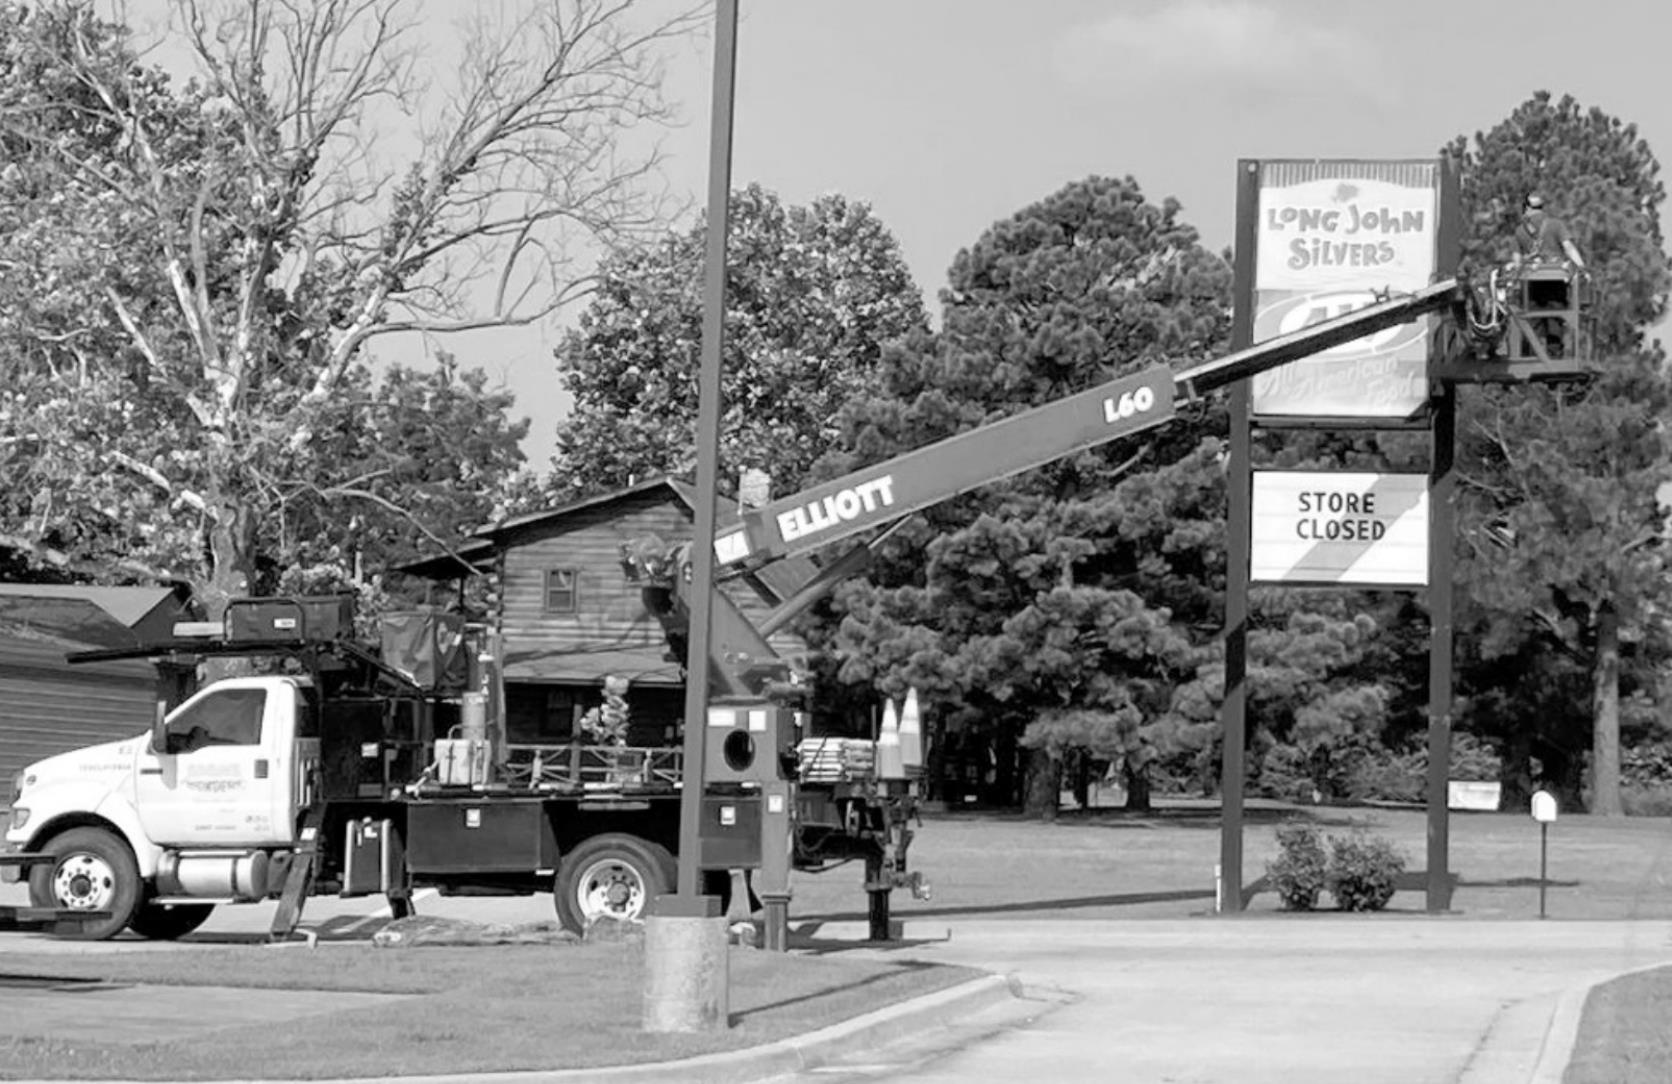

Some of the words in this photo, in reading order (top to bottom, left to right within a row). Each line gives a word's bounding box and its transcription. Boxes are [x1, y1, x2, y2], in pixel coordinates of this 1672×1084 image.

[1103, 387, 1154, 422] L60
[777, 475, 894, 542] ELLIOTT
[1298, 492, 1375, 513] STORE
[1296, 518, 1386, 541] CLOSED
